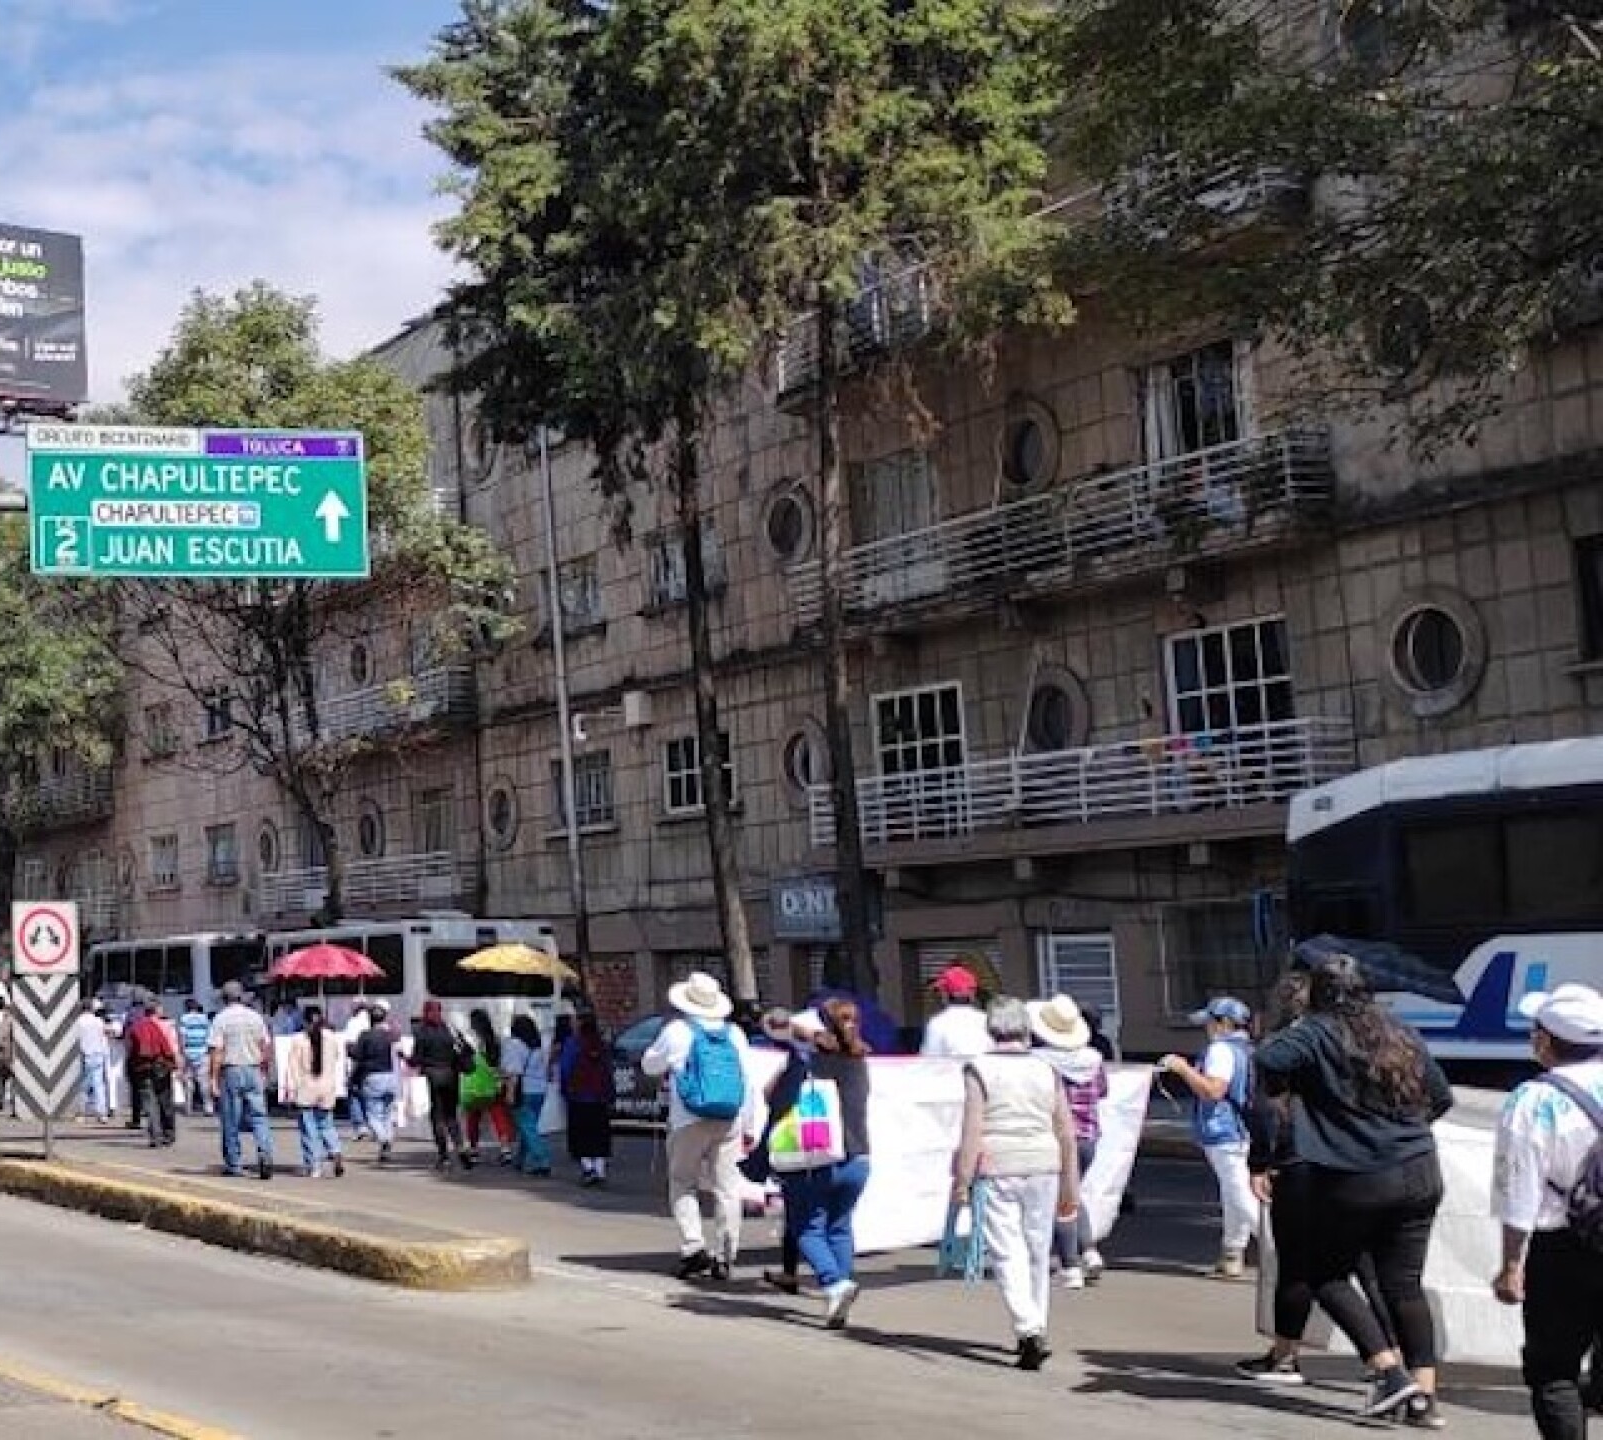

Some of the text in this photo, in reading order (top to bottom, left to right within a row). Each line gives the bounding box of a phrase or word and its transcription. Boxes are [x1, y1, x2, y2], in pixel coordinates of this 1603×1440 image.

[19, 242, 41, 257] un
[34, 428, 190, 447] CIRCUITO BICENTENARIO
[239, 437, 306, 455] TOLUCA
[48, 462, 302, 494] AV CHAPULTEPEC
[97, 502, 232, 525] CHAPULTEPEC
[99, 535, 304, 566] JUAN ESCUTIA
